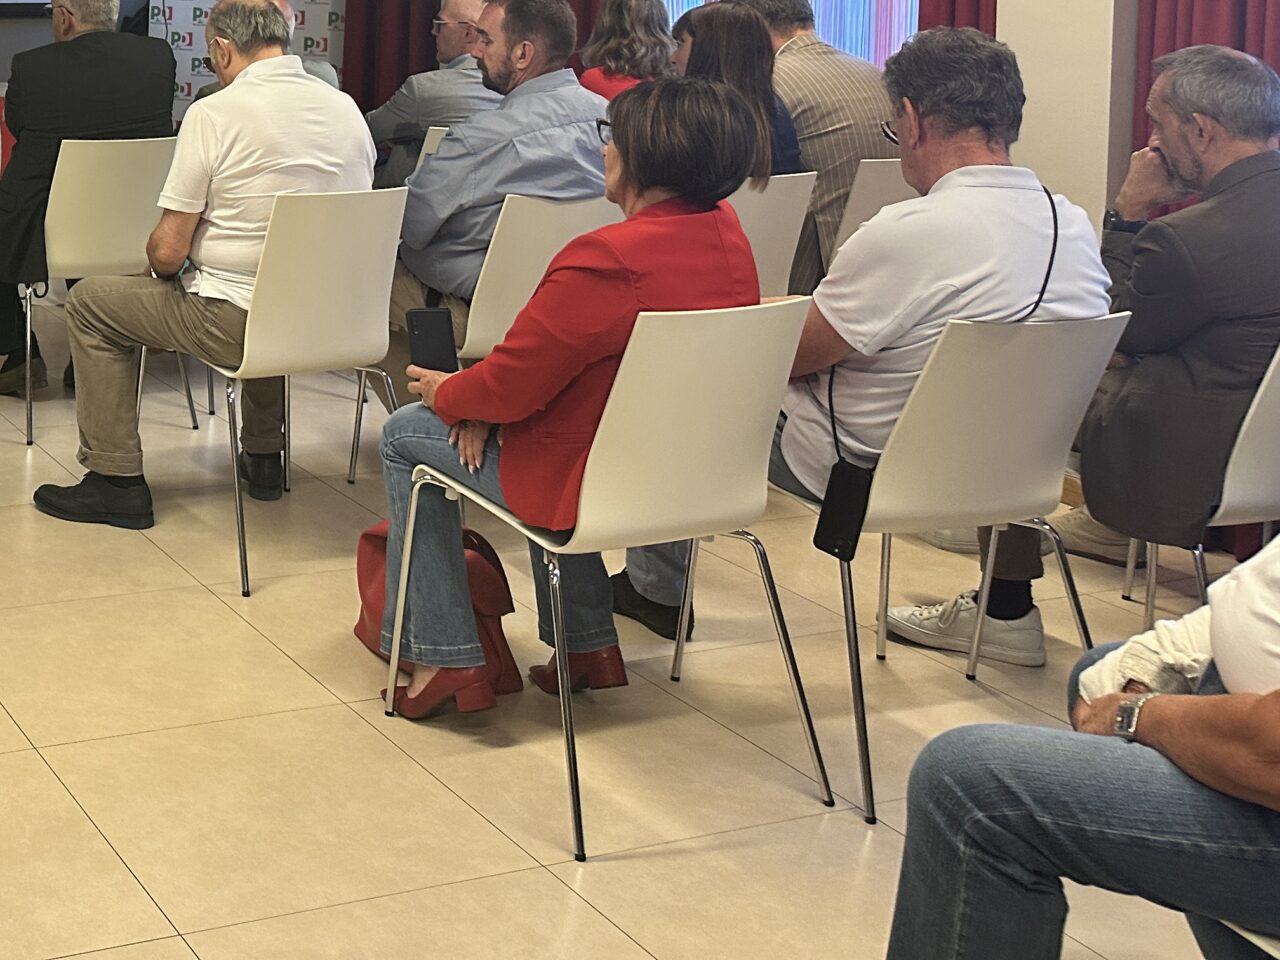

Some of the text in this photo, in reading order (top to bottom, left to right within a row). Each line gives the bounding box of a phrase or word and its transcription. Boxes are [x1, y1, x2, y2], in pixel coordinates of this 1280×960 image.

[150, 6, 172, 20] PD
[171, 32, 193, 46] PD
[303, 37, 328, 52] PD
